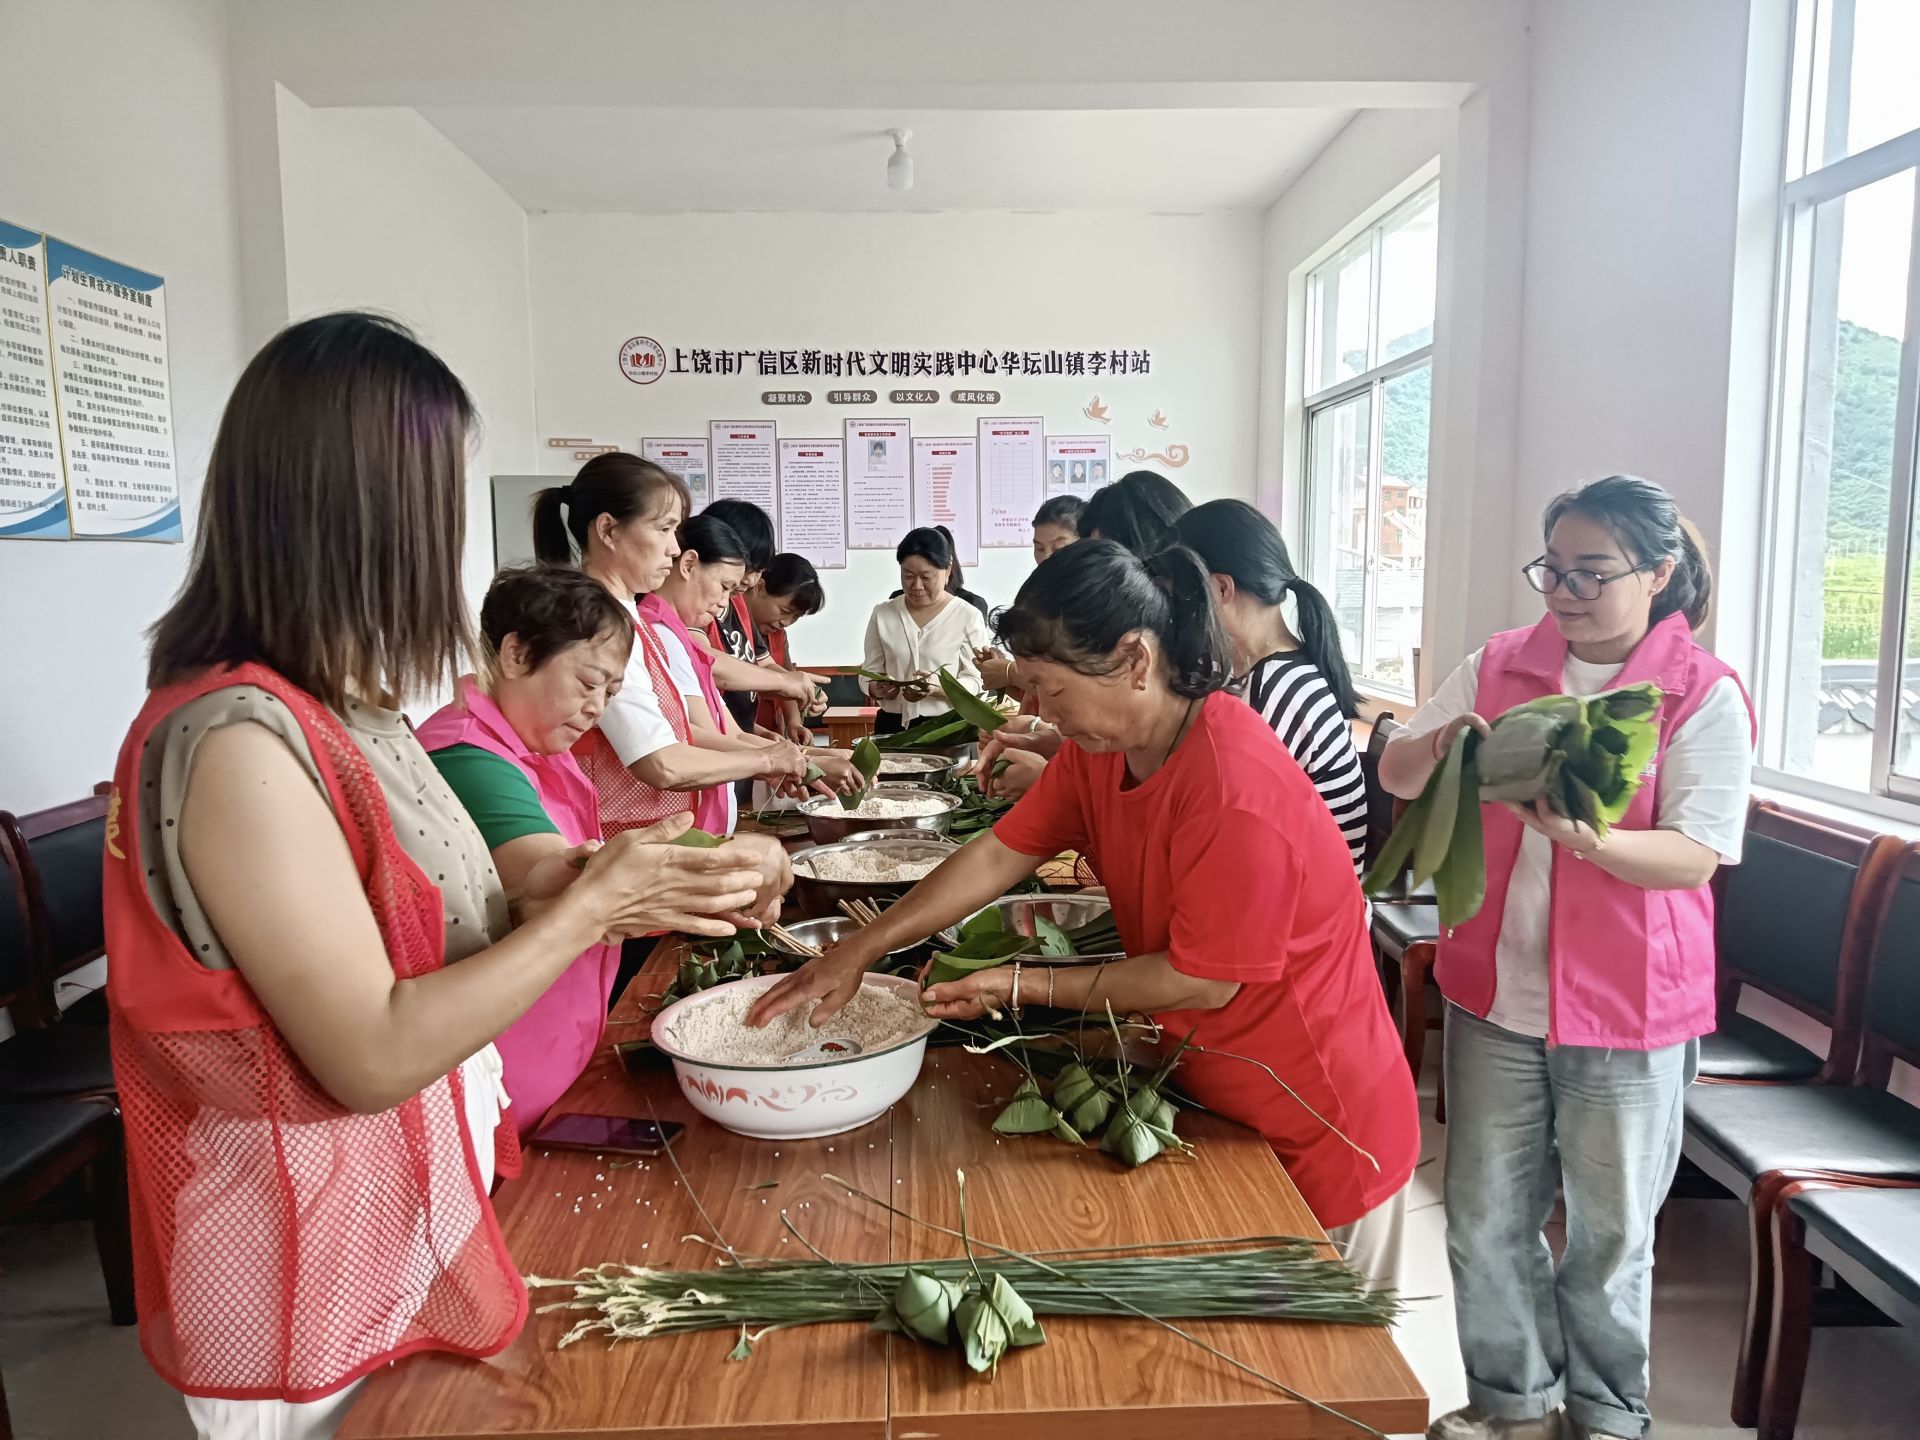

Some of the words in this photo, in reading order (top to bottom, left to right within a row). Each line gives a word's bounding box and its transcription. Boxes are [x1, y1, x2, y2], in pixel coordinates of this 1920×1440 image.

[62, 267, 153, 308] 计划生育技术服务室制度
[670, 348, 1150, 376] 上饶市广信区新时代文明实践中心华坛山镇李村站
[767, 393, 806, 403] 凝聚群众
[833, 392, 871, 402] 引导群众
[896, 392, 933, 402] 以文化人
[957, 392, 995, 402] 成风化俗
